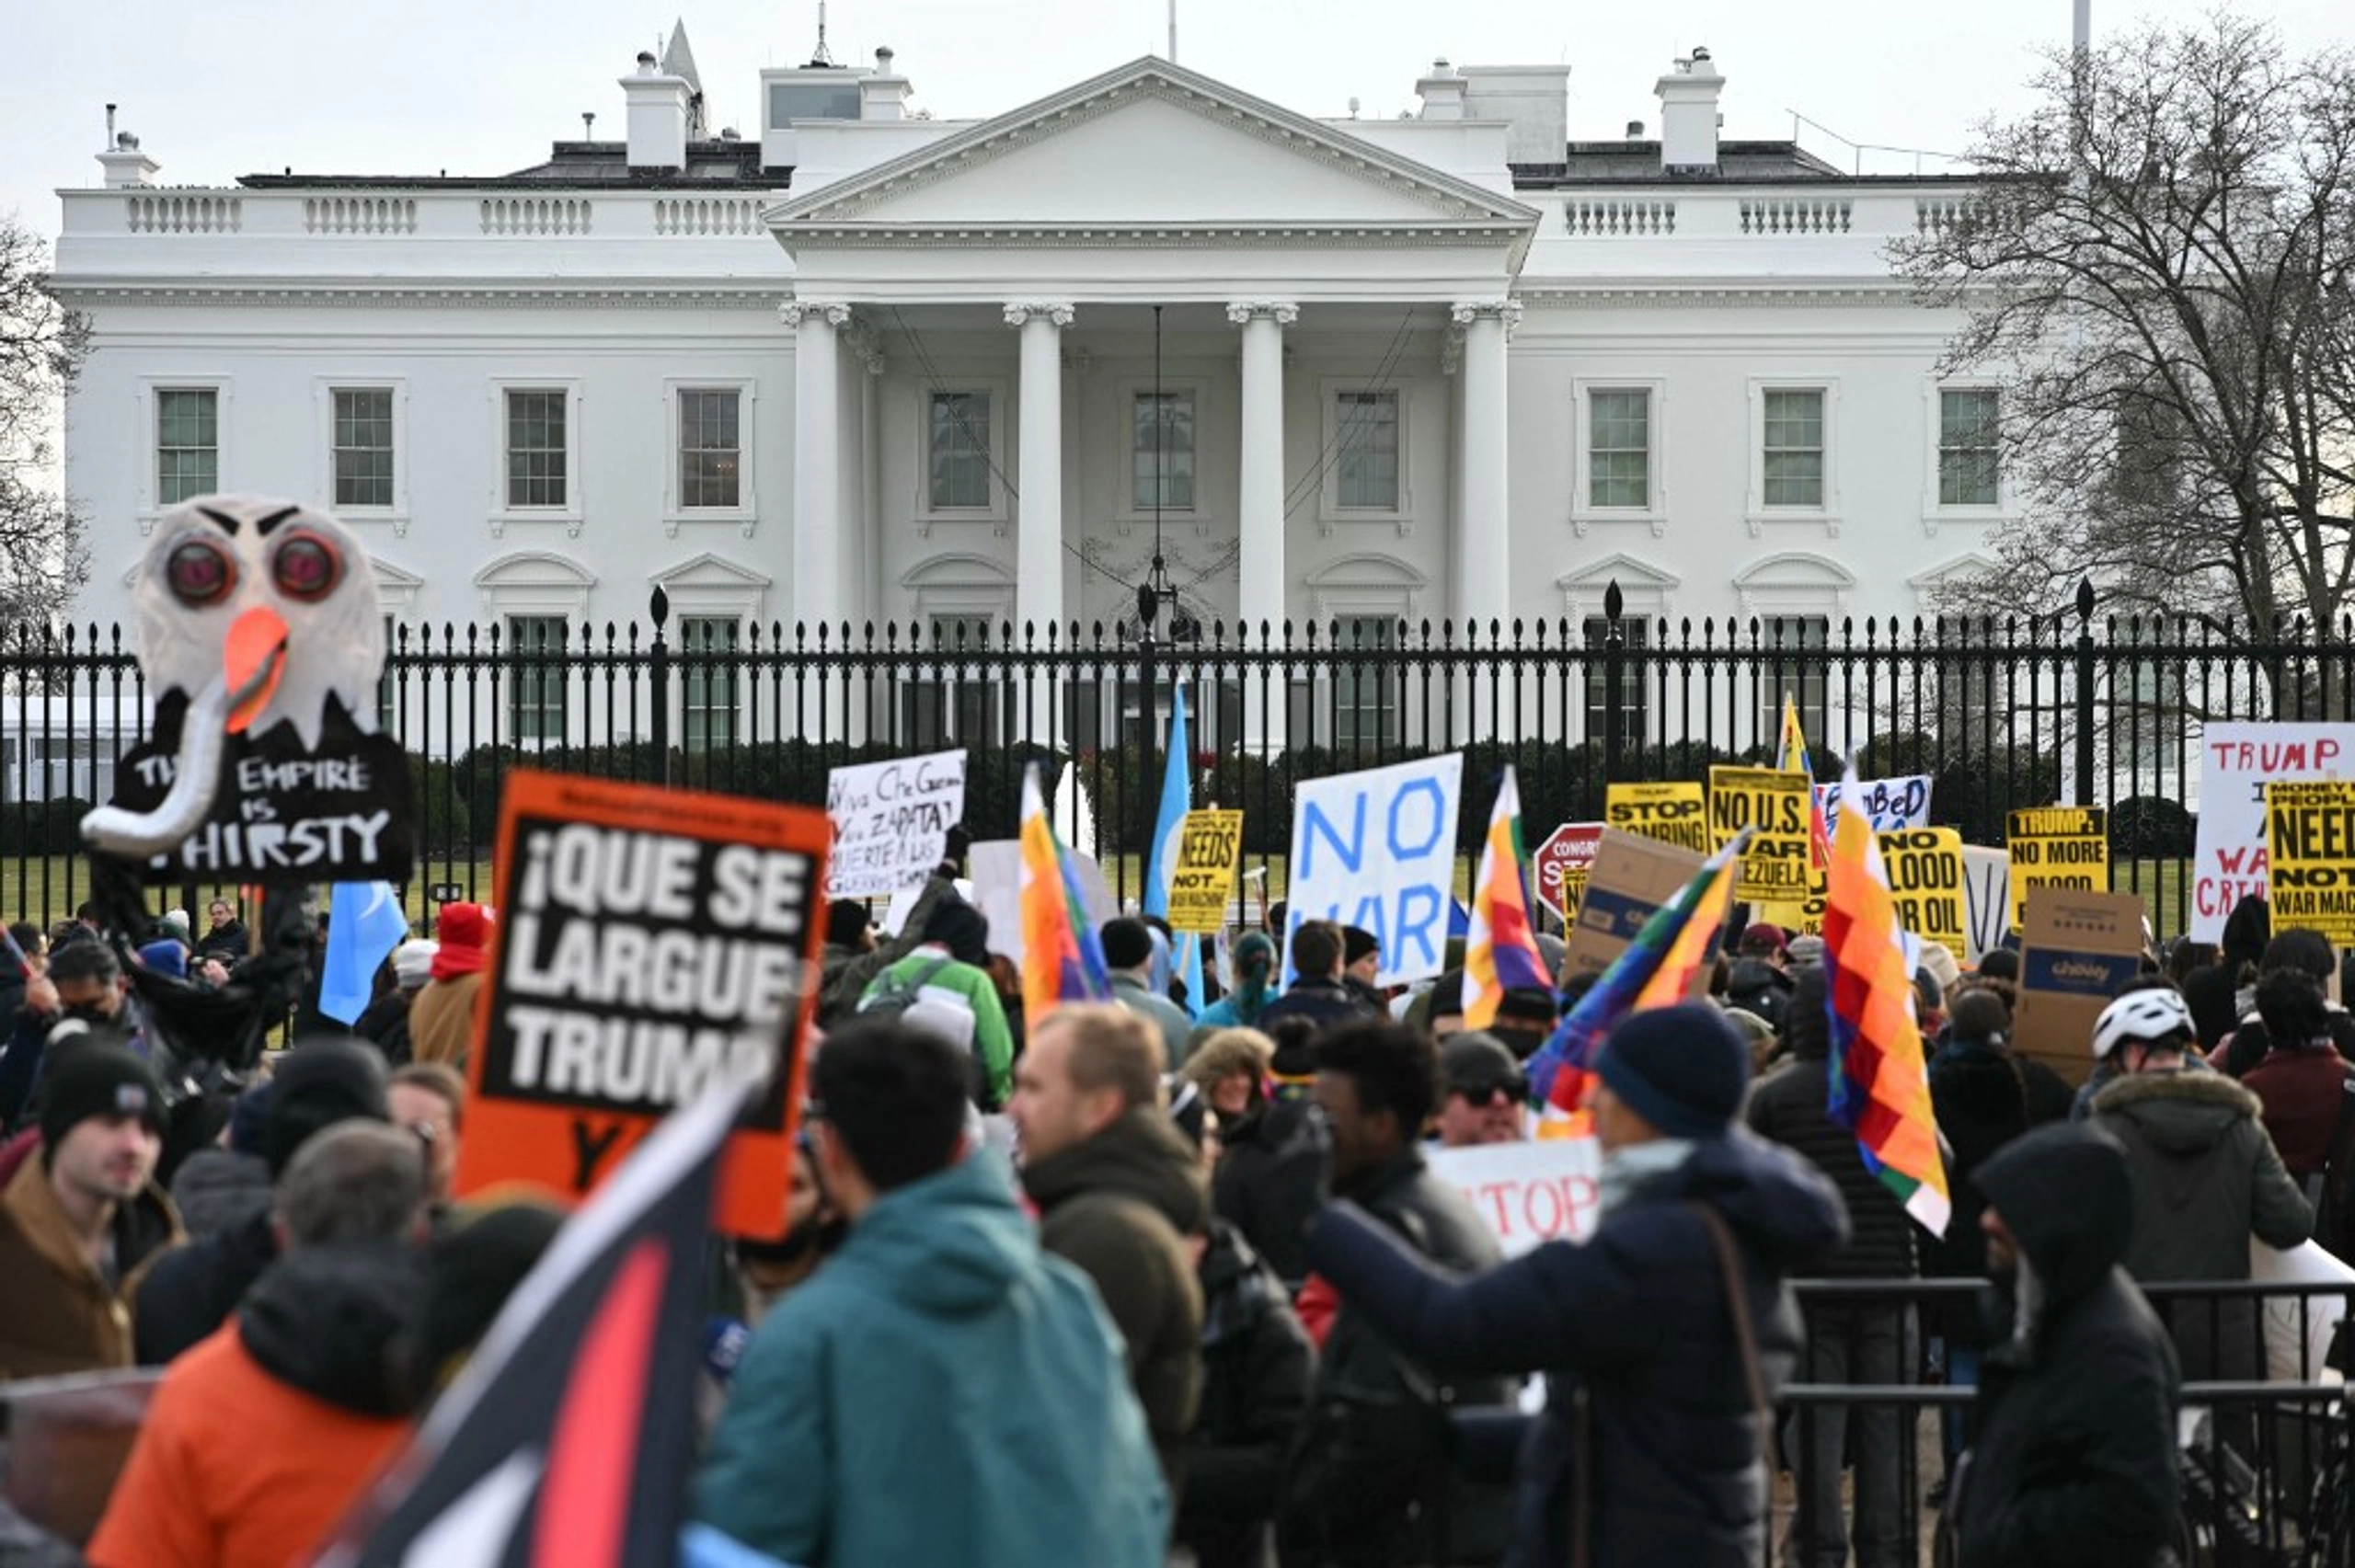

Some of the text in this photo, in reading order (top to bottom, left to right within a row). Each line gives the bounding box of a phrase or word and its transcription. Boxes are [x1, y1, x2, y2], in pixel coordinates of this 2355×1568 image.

[134, 755, 371, 791] TH EMPIRE
[2211, 738, 2339, 773] TRUMP
[241, 797, 275, 822] IS
[1610, 799, 1702, 822] STOP
[1714, 790, 1749, 830] NO
[1756, 793, 1807, 835] U.S.
[2272, 796, 2355, 807] PEOPL
[150, 809, 390, 871] HIRSTY
[1298, 776, 1446, 880] NO
[1616, 821, 1704, 853] BING
[1878, 831, 1939, 853] NO
[1178, 830, 1237, 868] NEEDS
[2011, 840, 2104, 864] NO MORE
[2217, 846, 2269, 876] WA
[520, 822, 807, 934] ¡QUE SE
[1172, 873, 1215, 888] NOT
[1739, 860, 1807, 887] EZUELA
[1884, 852, 1958, 892] LOOD
[1924, 897, 1963, 934] OIL
[2274, 891, 2355, 914] WAR MAC
[505, 912, 793, 1026] LARGUE
[1462, 1173, 1600, 1239] TOP
